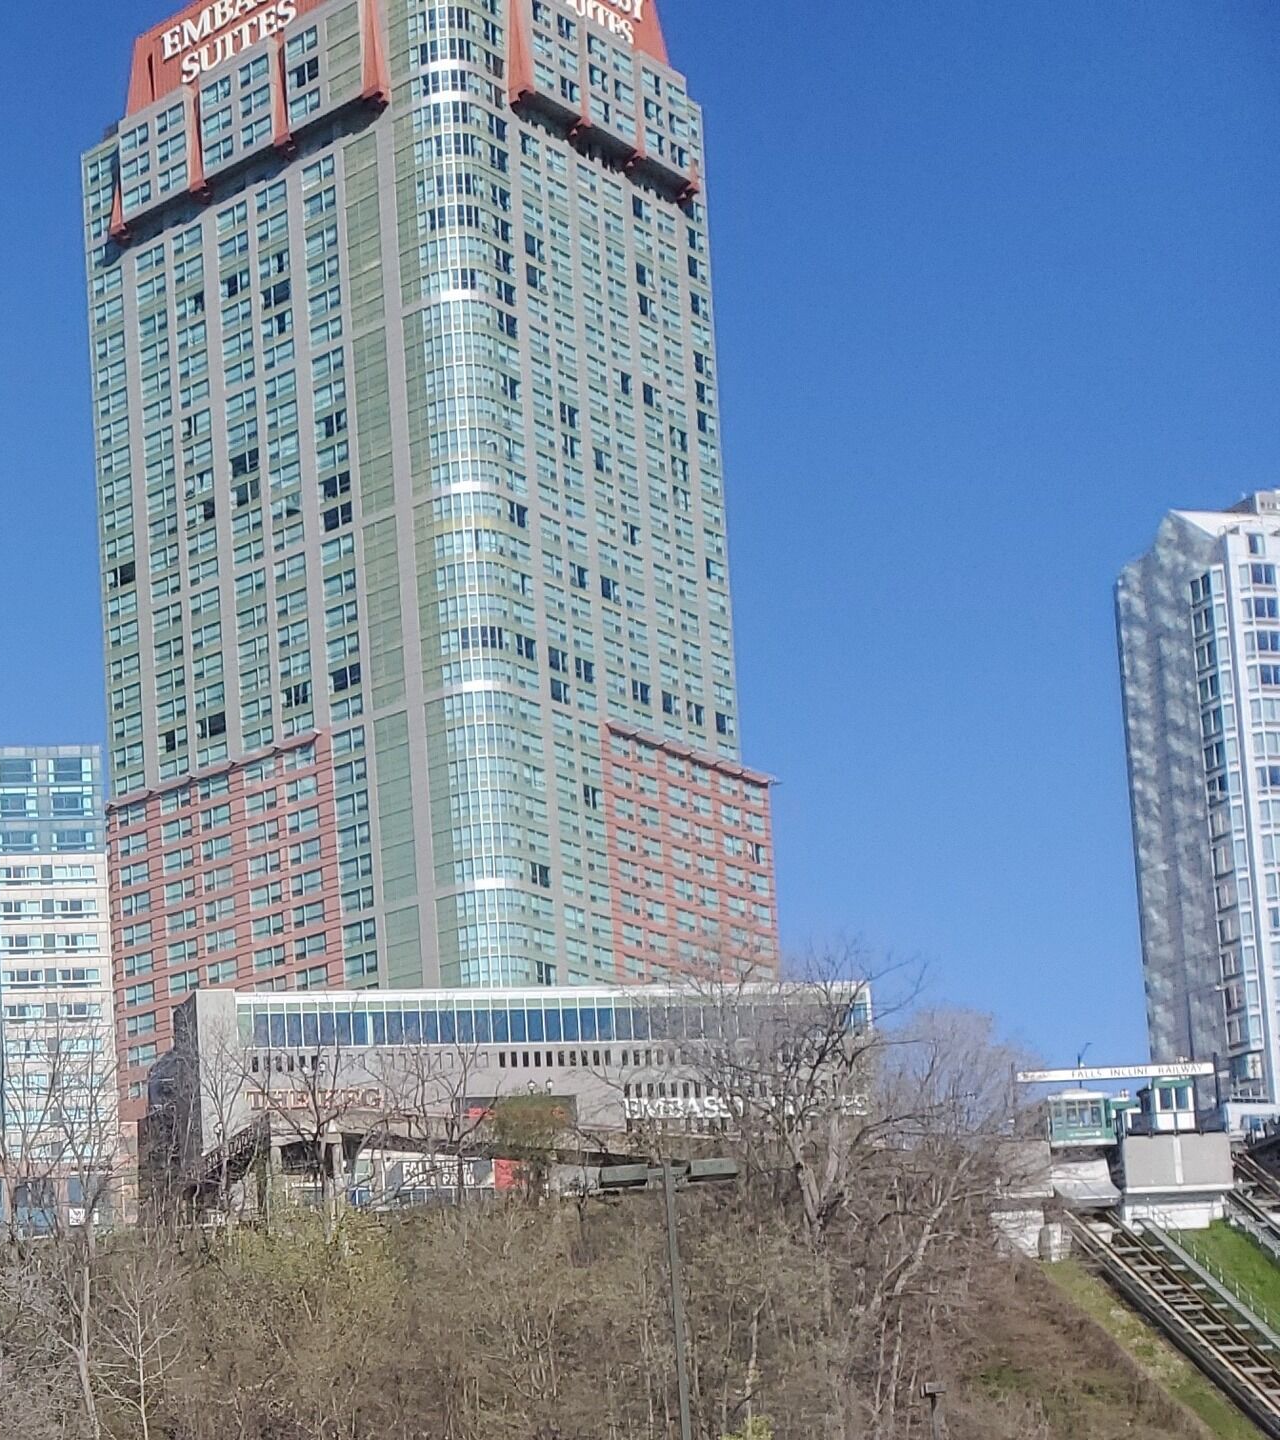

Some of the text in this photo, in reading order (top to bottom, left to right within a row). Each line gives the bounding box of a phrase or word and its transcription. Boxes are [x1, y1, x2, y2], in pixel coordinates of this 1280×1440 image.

[161, 0, 267, 60] EMBA
[181, 0, 297, 83] SUITES
[566, 0, 635, 44] UITES
[1071, 1064, 1203, 1078] FALLS INCLINE RAILWAY
[243, 1088, 384, 1110] THE KEG
